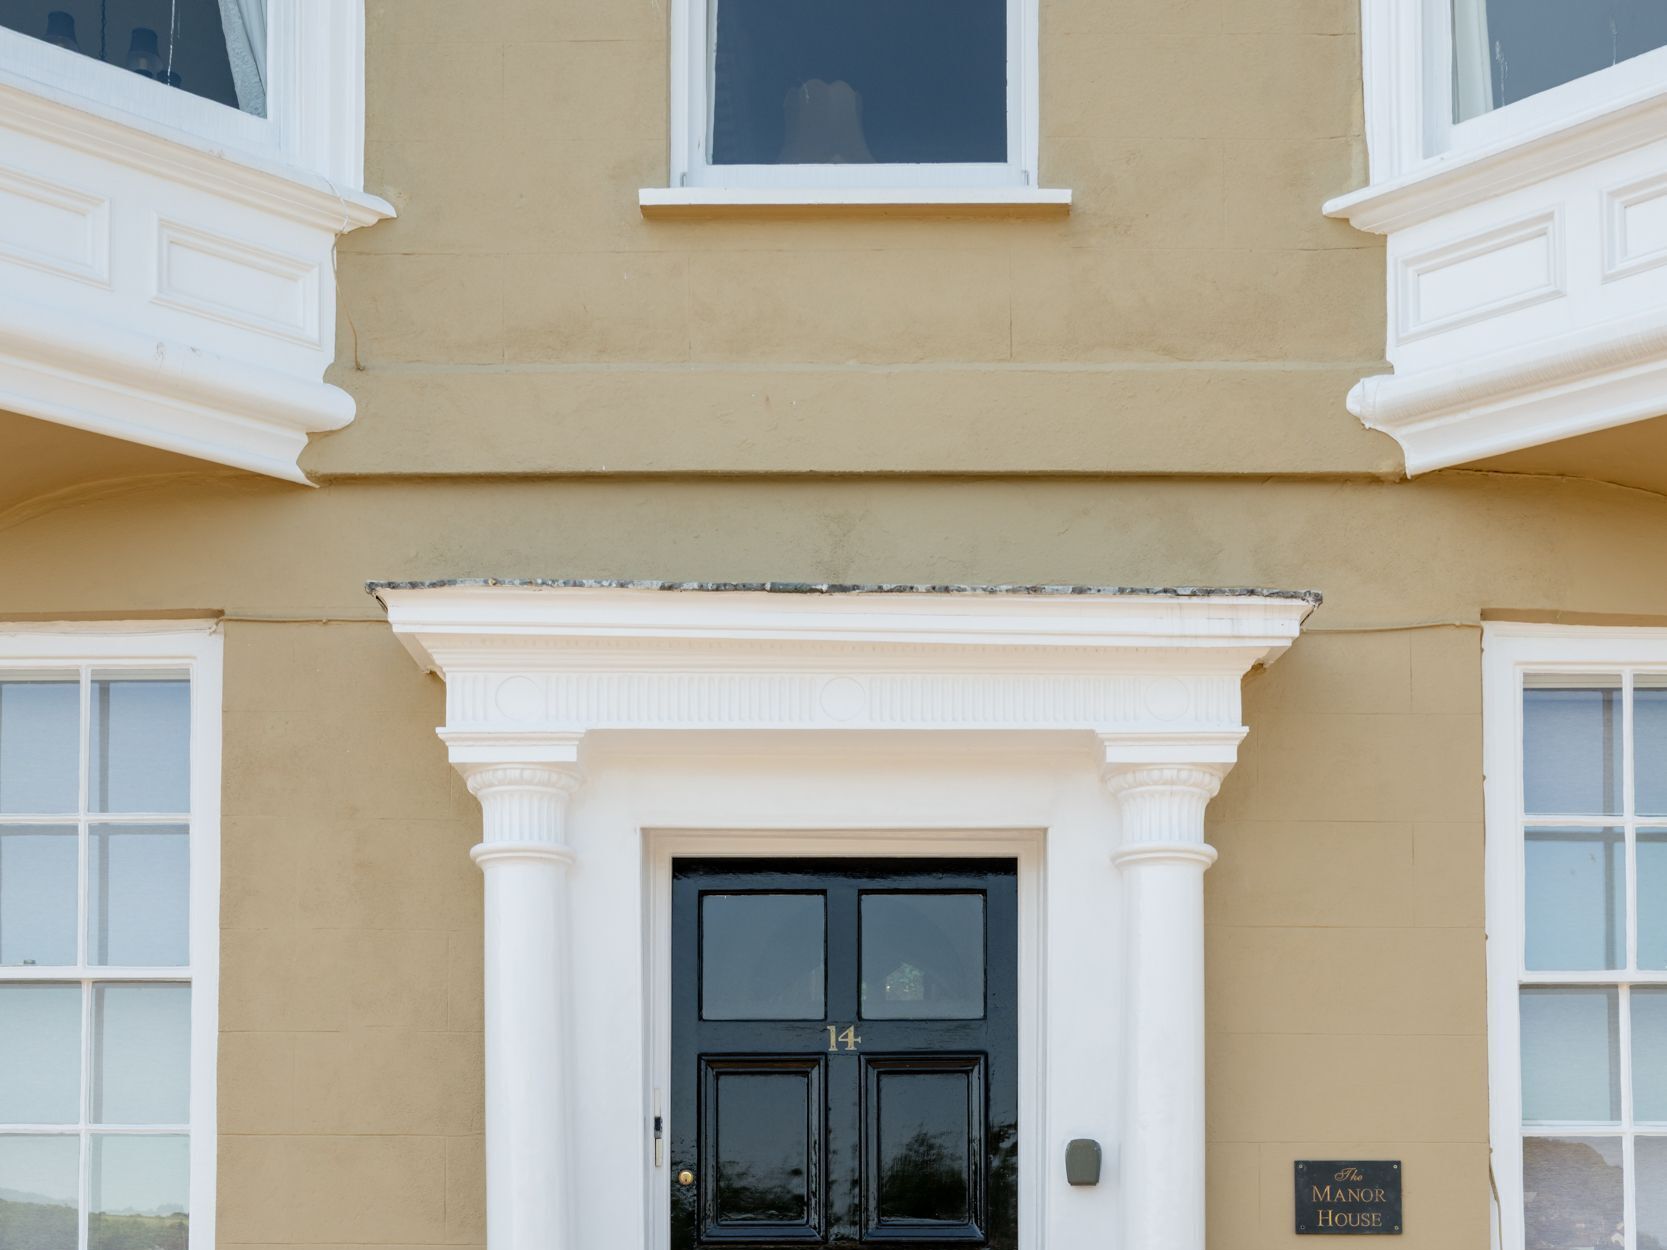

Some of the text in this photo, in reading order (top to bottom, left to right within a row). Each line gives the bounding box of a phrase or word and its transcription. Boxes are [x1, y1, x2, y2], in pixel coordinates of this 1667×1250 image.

[827, 1025, 861, 1051] 14
[1334, 1168, 1363, 1181] The
[1312, 1184, 1386, 1202] MANOR
[1317, 1209, 1382, 1227] HOUSE
